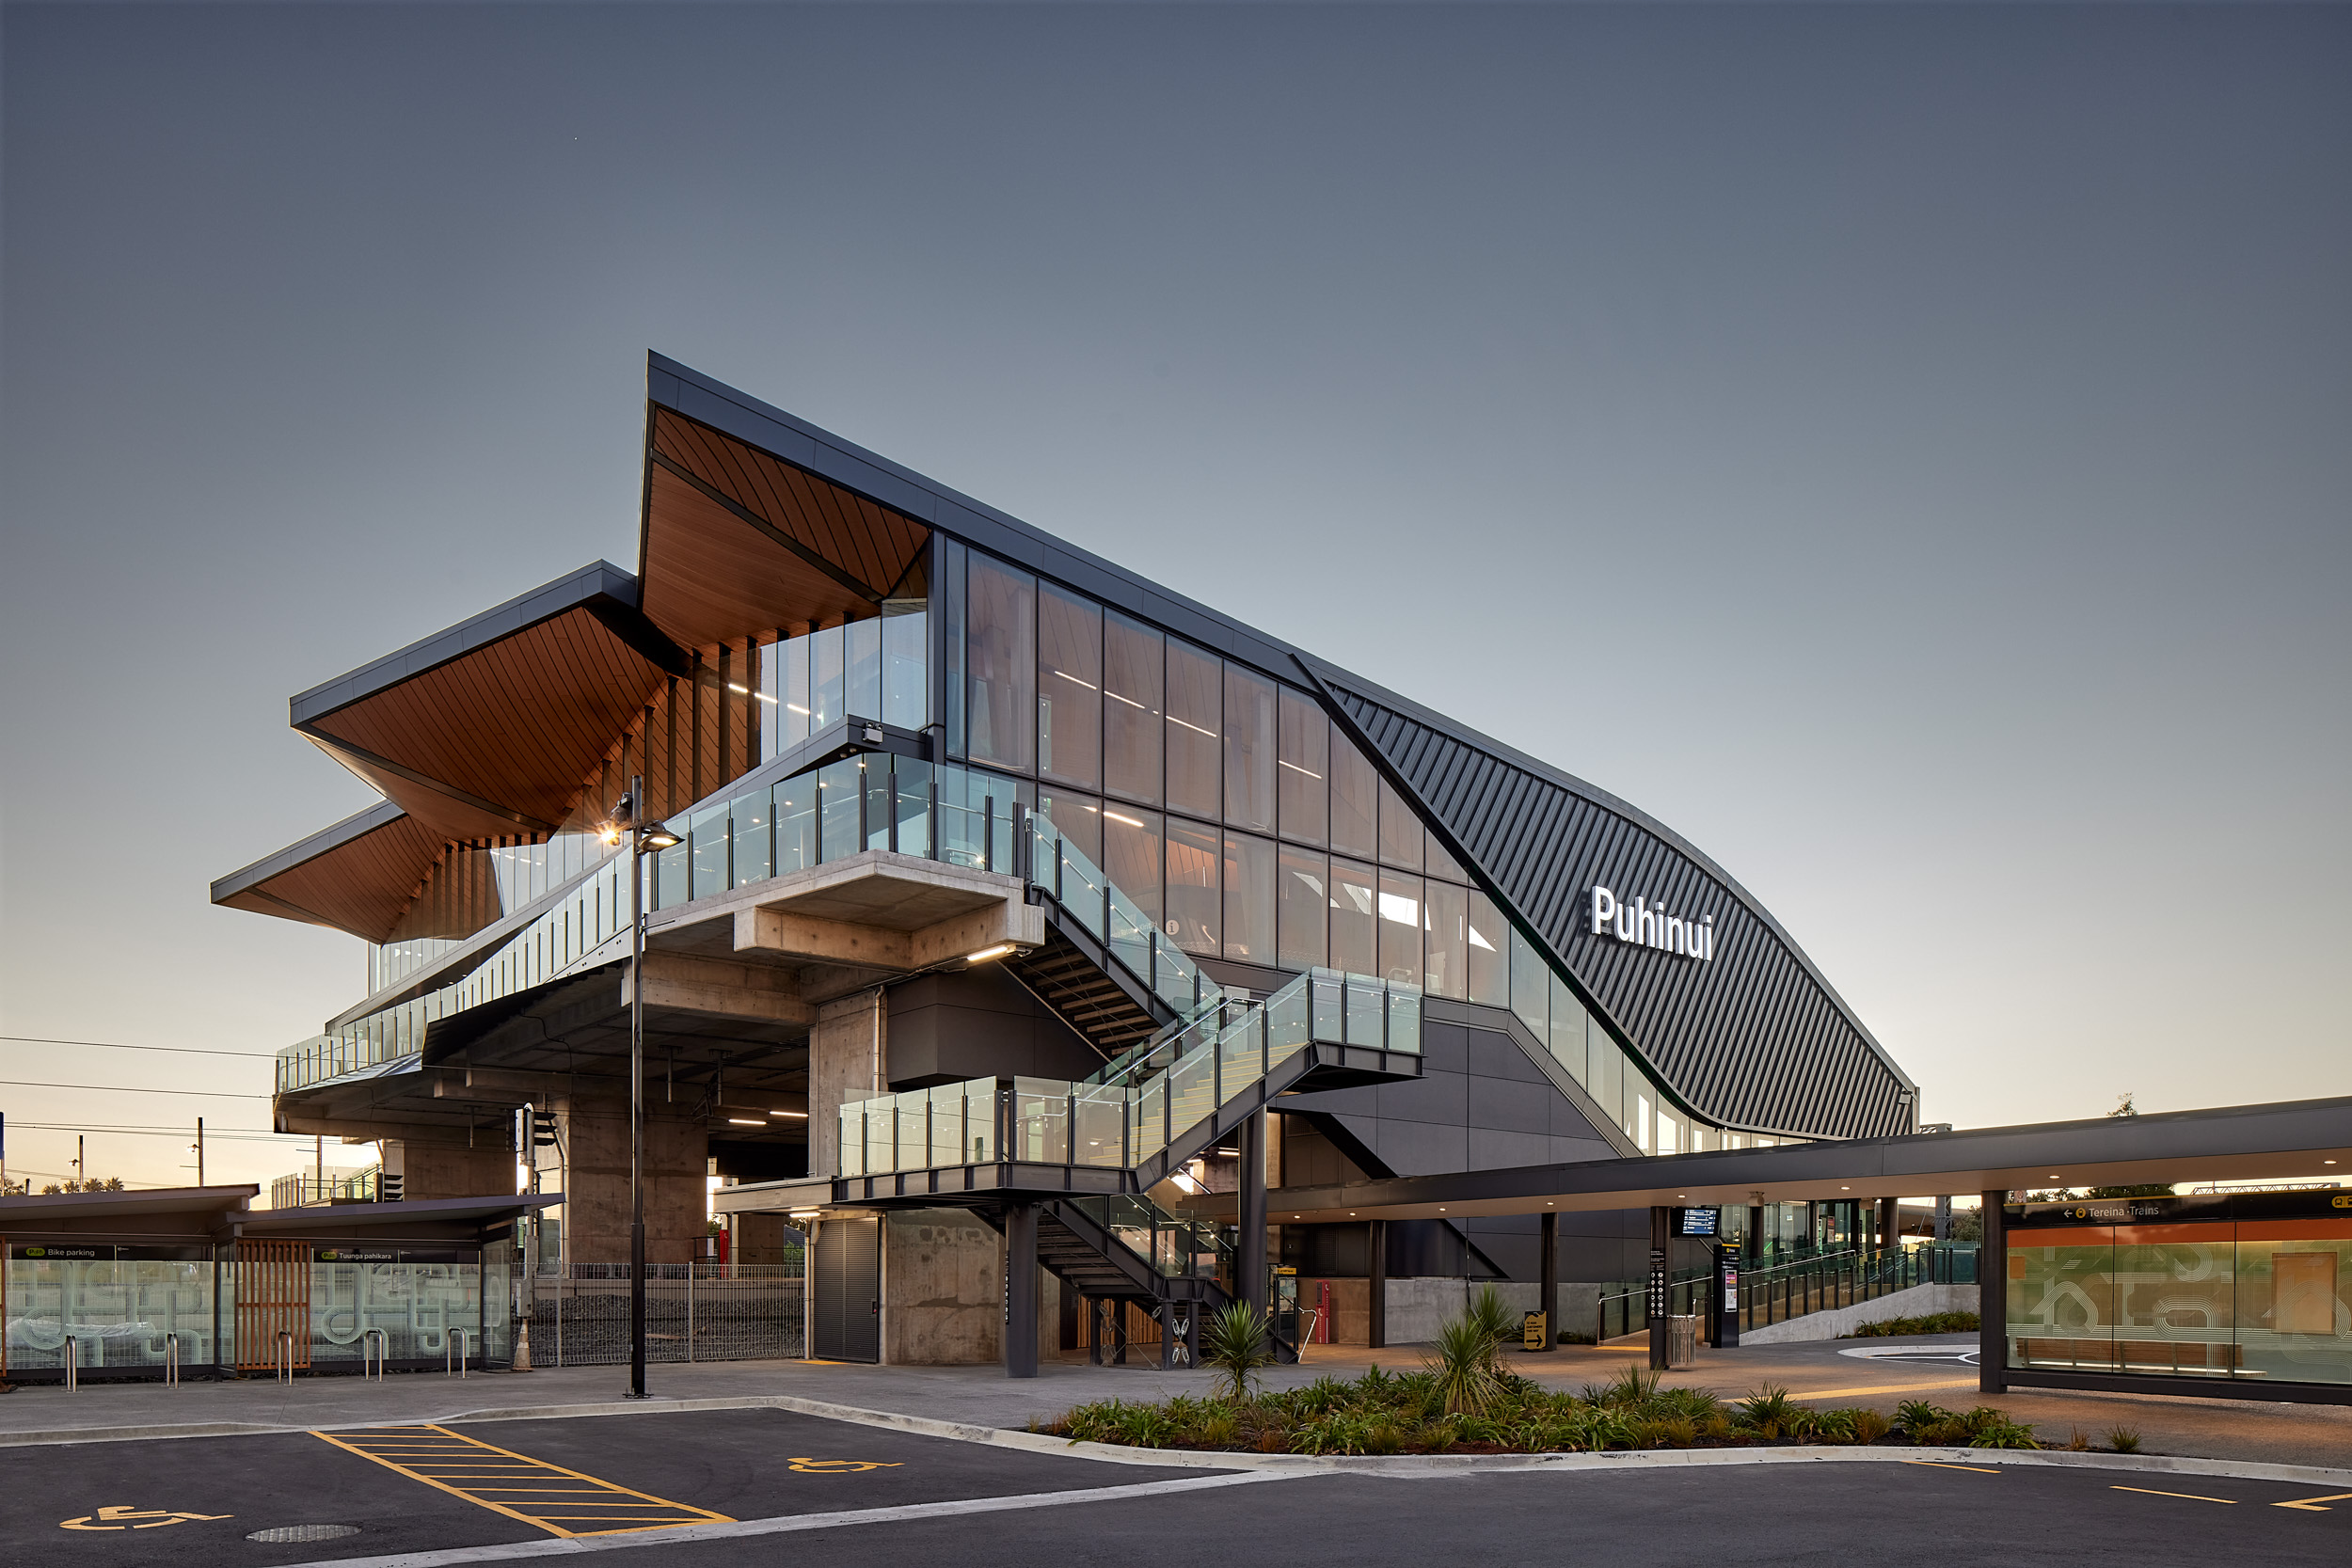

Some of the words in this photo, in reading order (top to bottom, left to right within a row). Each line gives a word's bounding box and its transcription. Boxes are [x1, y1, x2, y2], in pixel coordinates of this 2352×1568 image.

[1591, 885, 1712, 961] Puhinui
[2089, 1207, 2125, 1218] Tereina
[2129, 1205, 2159, 1216] Trains
[66, 1248, 95, 1258] parking
[339, 1252, 363, 1260] Tuunga
[364, 1252, 392, 1260] pahikara
